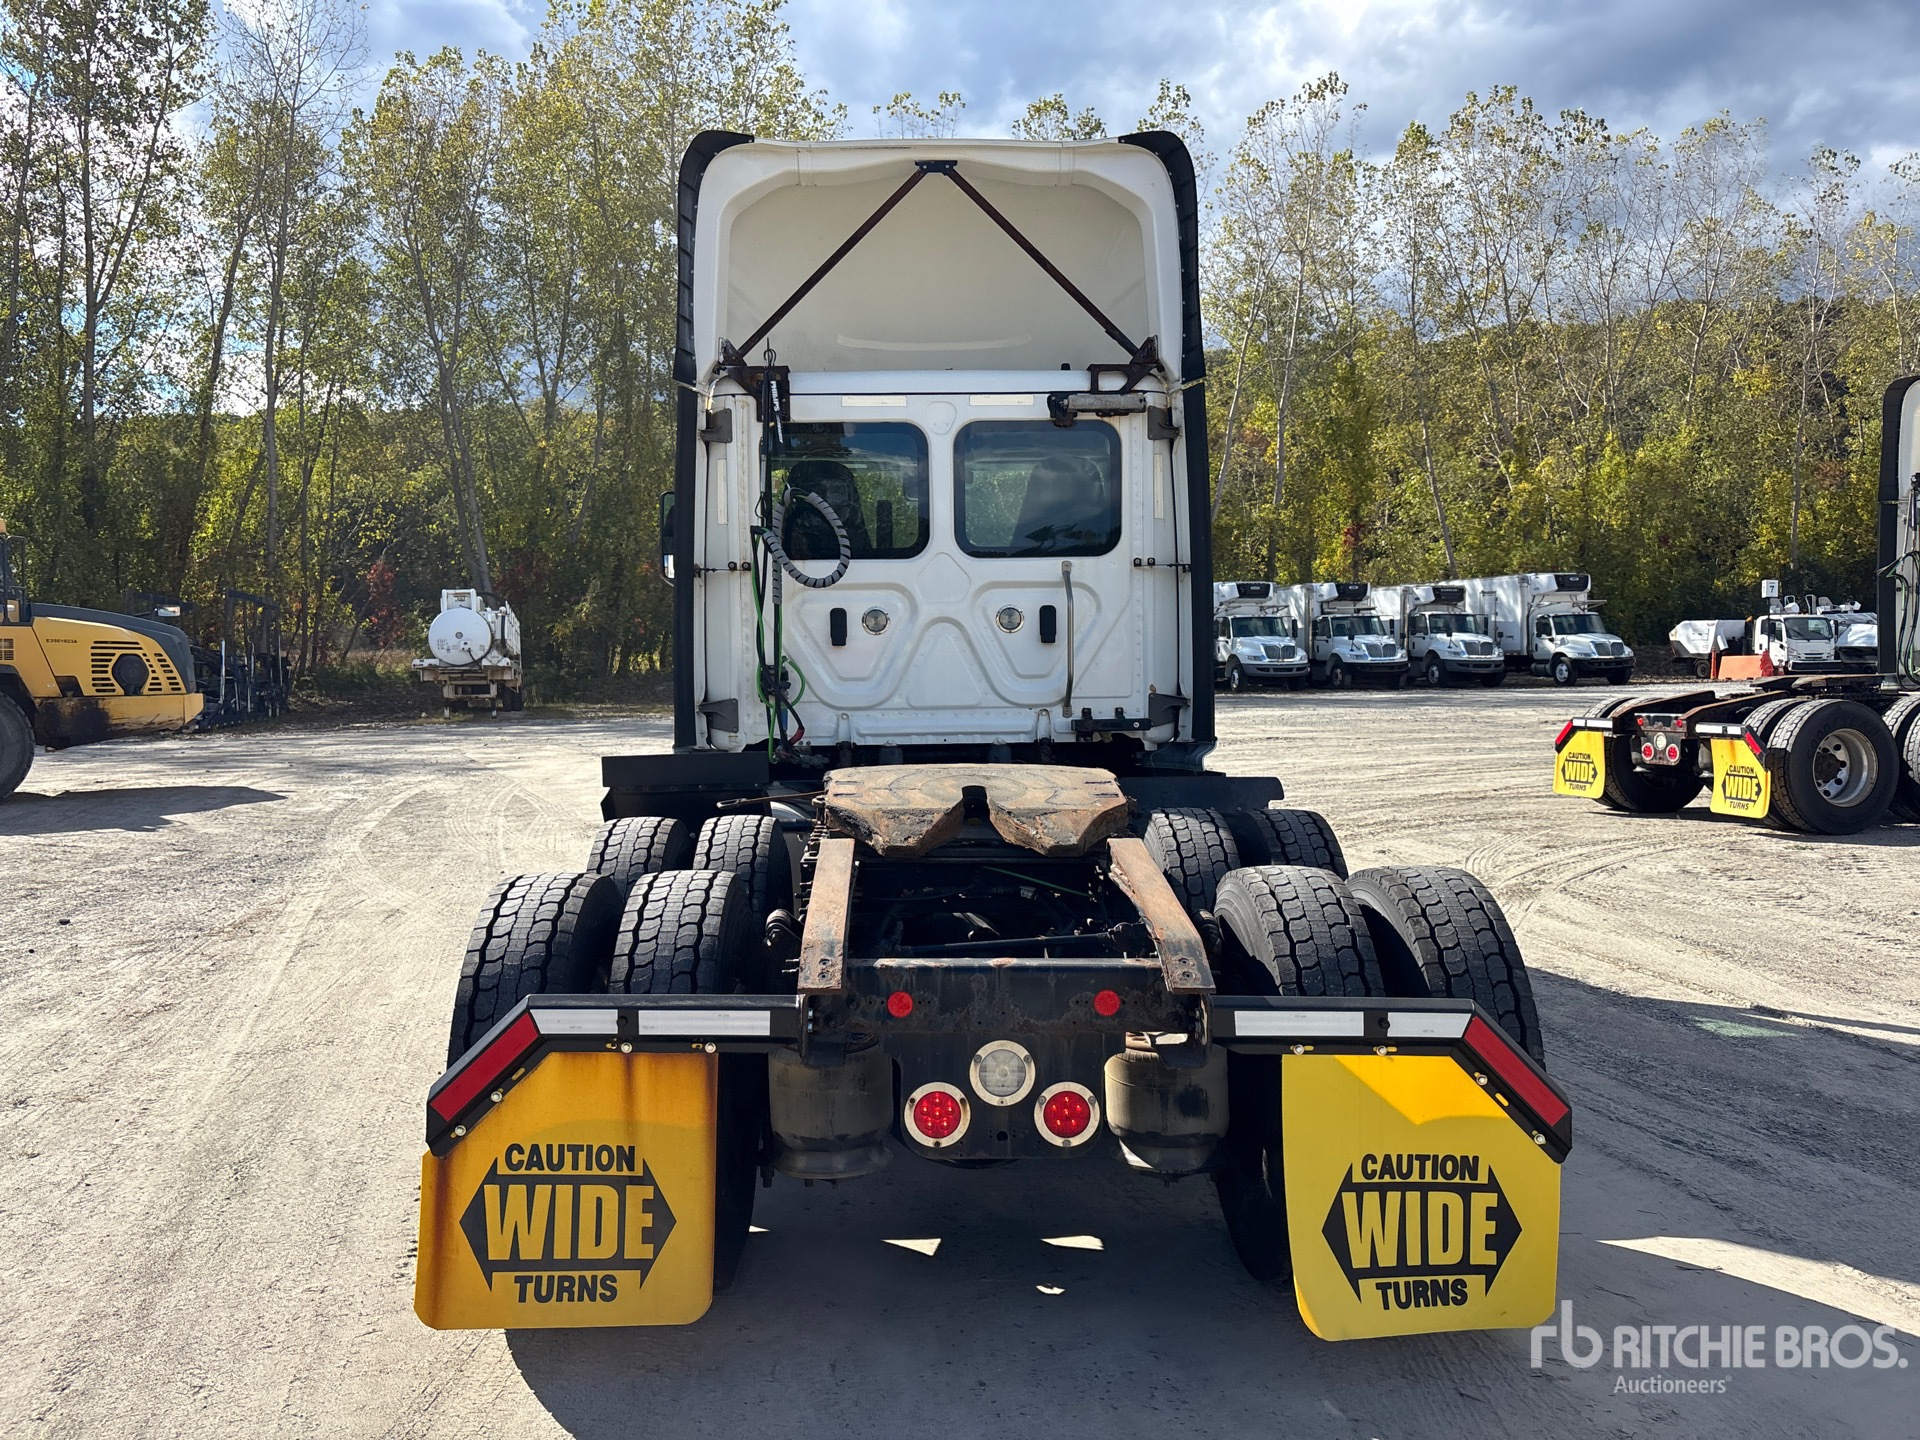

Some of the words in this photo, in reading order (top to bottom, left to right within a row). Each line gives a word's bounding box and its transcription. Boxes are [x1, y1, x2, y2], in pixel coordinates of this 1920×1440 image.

[1568, 752, 1591, 760] CAUTION
[1565, 761, 1595, 783] WIDE
[1729, 765, 1755, 775] CAUTION
[1569, 783, 1587, 791] TURNS
[1725, 775, 1759, 801] WIDE
[1729, 801, 1749, 811] TURNS
[504, 1143, 636, 1172] CAUTION
[1361, 1153, 1480, 1181] CAUTION
[483, 1184, 655, 1261] WIDE
[1341, 1191, 1499, 1269] WIDE
[514, 1275, 618, 1303] TURNS
[1376, 1278, 1468, 1311] TURNS
